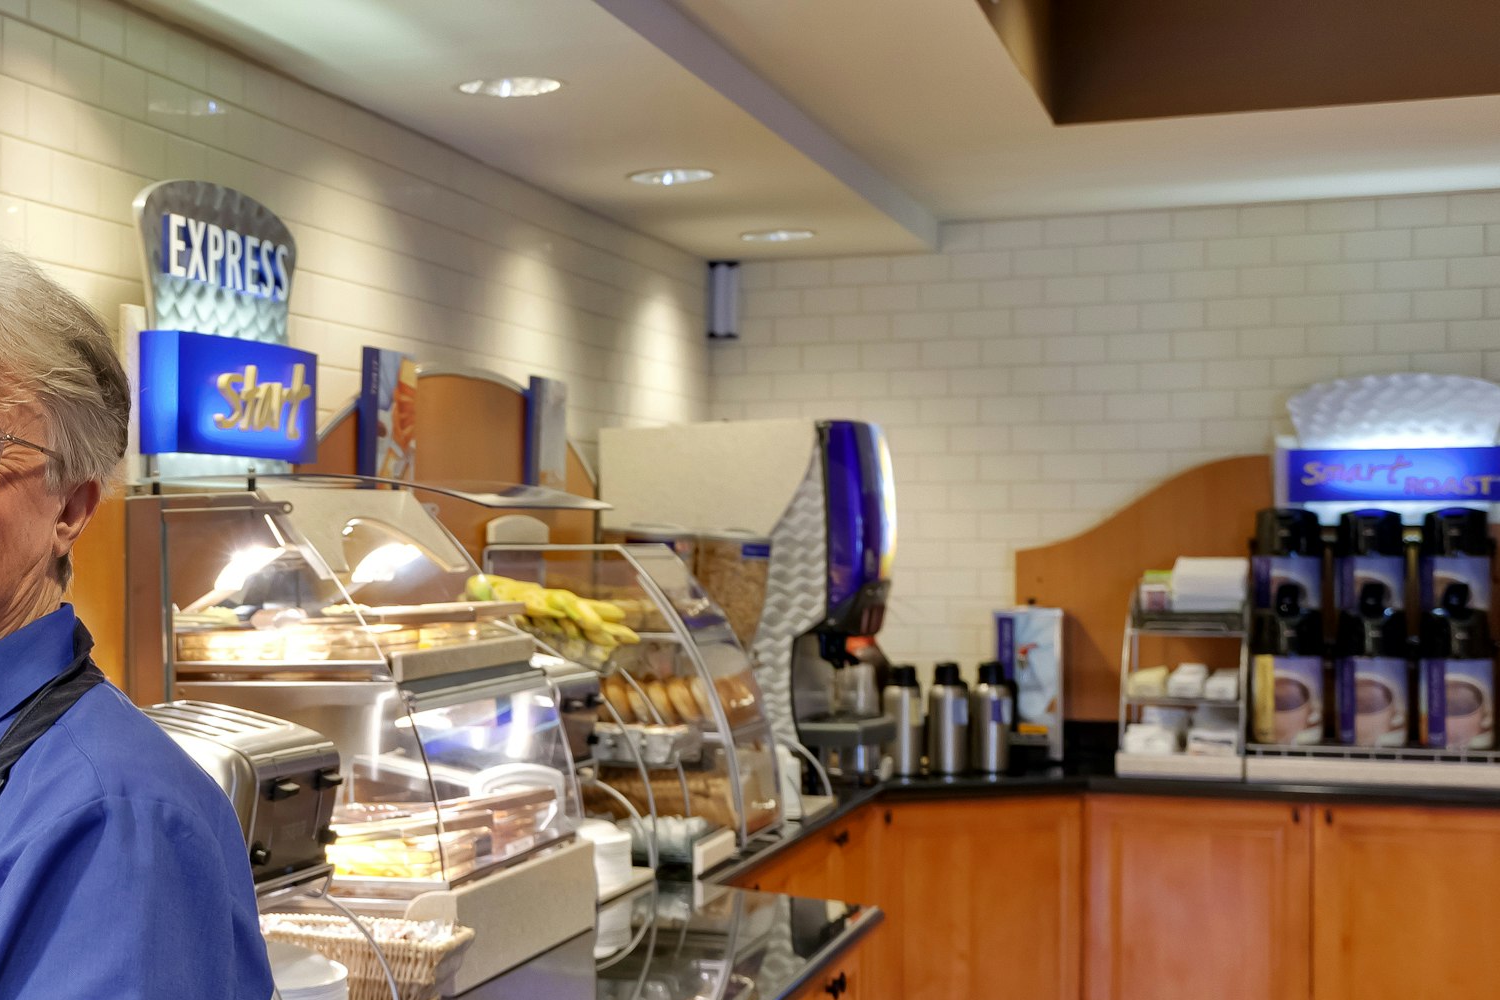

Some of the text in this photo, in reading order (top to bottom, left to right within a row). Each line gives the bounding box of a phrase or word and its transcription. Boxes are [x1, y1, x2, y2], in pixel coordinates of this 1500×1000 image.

[168, 213, 288, 300] EXPRESS
[214, 364, 311, 440] Start
[1301, 455, 1496, 496] Smart ROAST
